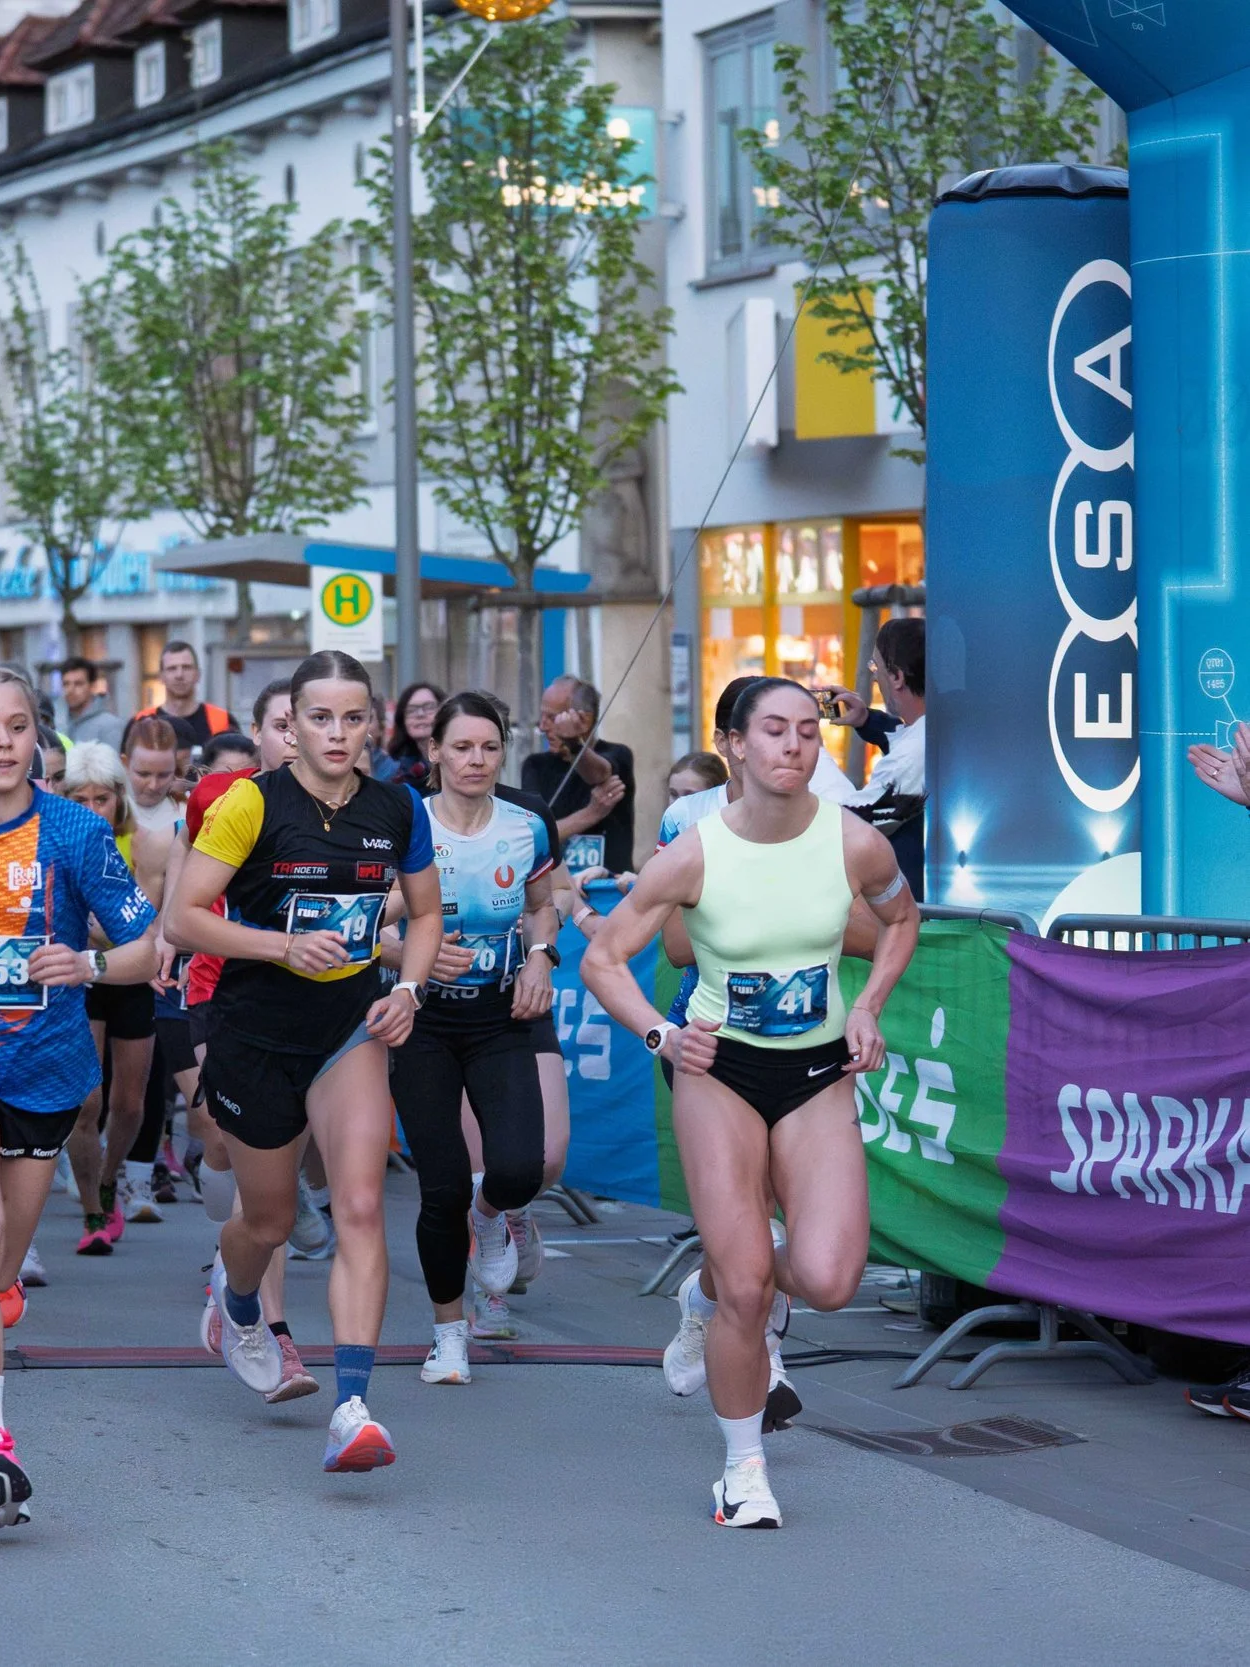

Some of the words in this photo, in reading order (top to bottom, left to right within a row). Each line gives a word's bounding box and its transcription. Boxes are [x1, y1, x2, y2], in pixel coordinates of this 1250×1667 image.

[335, 585, 360, 615] H
[565, 848, 599, 866] 210
[340, 914, 367, 941] 19
[776, 987, 812, 1014] 41
